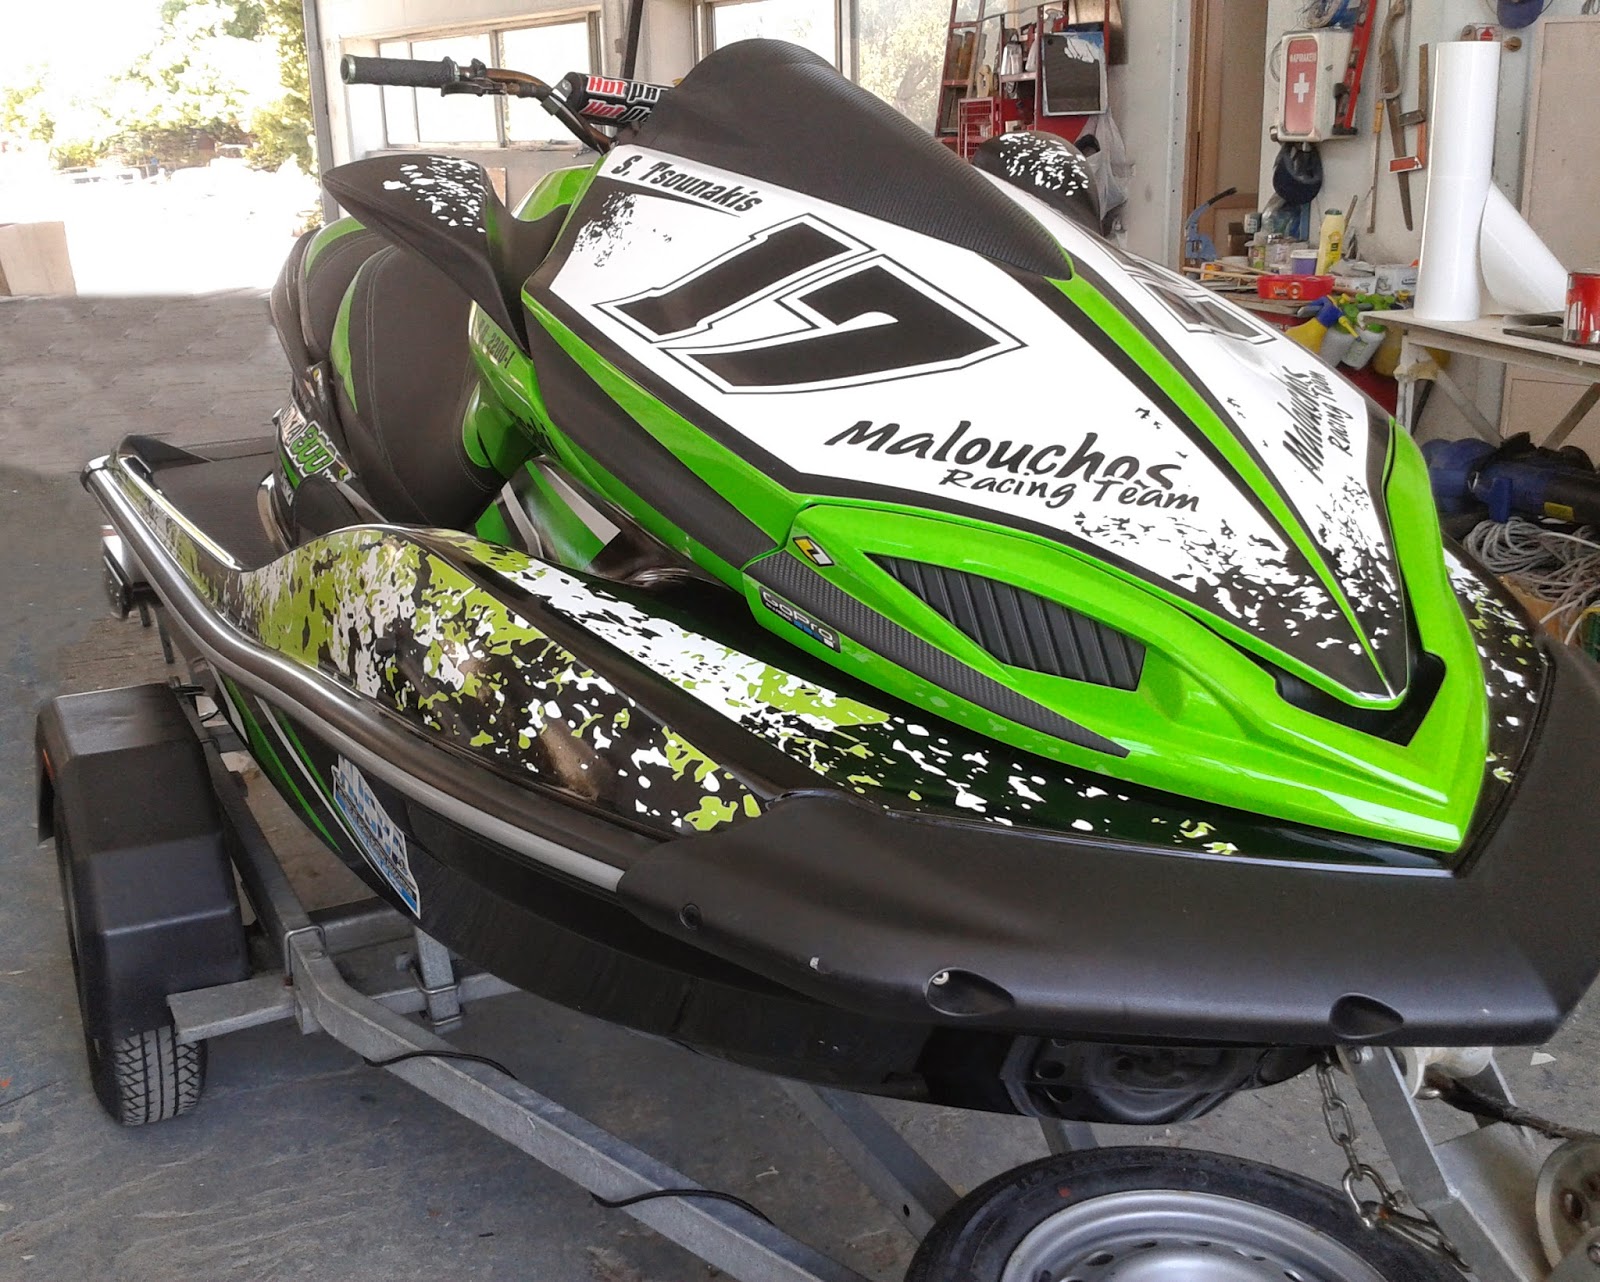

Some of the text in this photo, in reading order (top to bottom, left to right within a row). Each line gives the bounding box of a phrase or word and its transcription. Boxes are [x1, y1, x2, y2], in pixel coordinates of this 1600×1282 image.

[586, 75, 627, 97] Hot
[610, 154, 764, 213] S. Tsounakis
[592, 212, 1029, 395] 17
[288, 420, 341, 478] 300
[1270, 365, 1324, 485] Malouchos
[823, 420, 1183, 492] Malouchos
[938, 467, 1200, 513] Racing Team
[762, 590, 834, 641] GoPro
